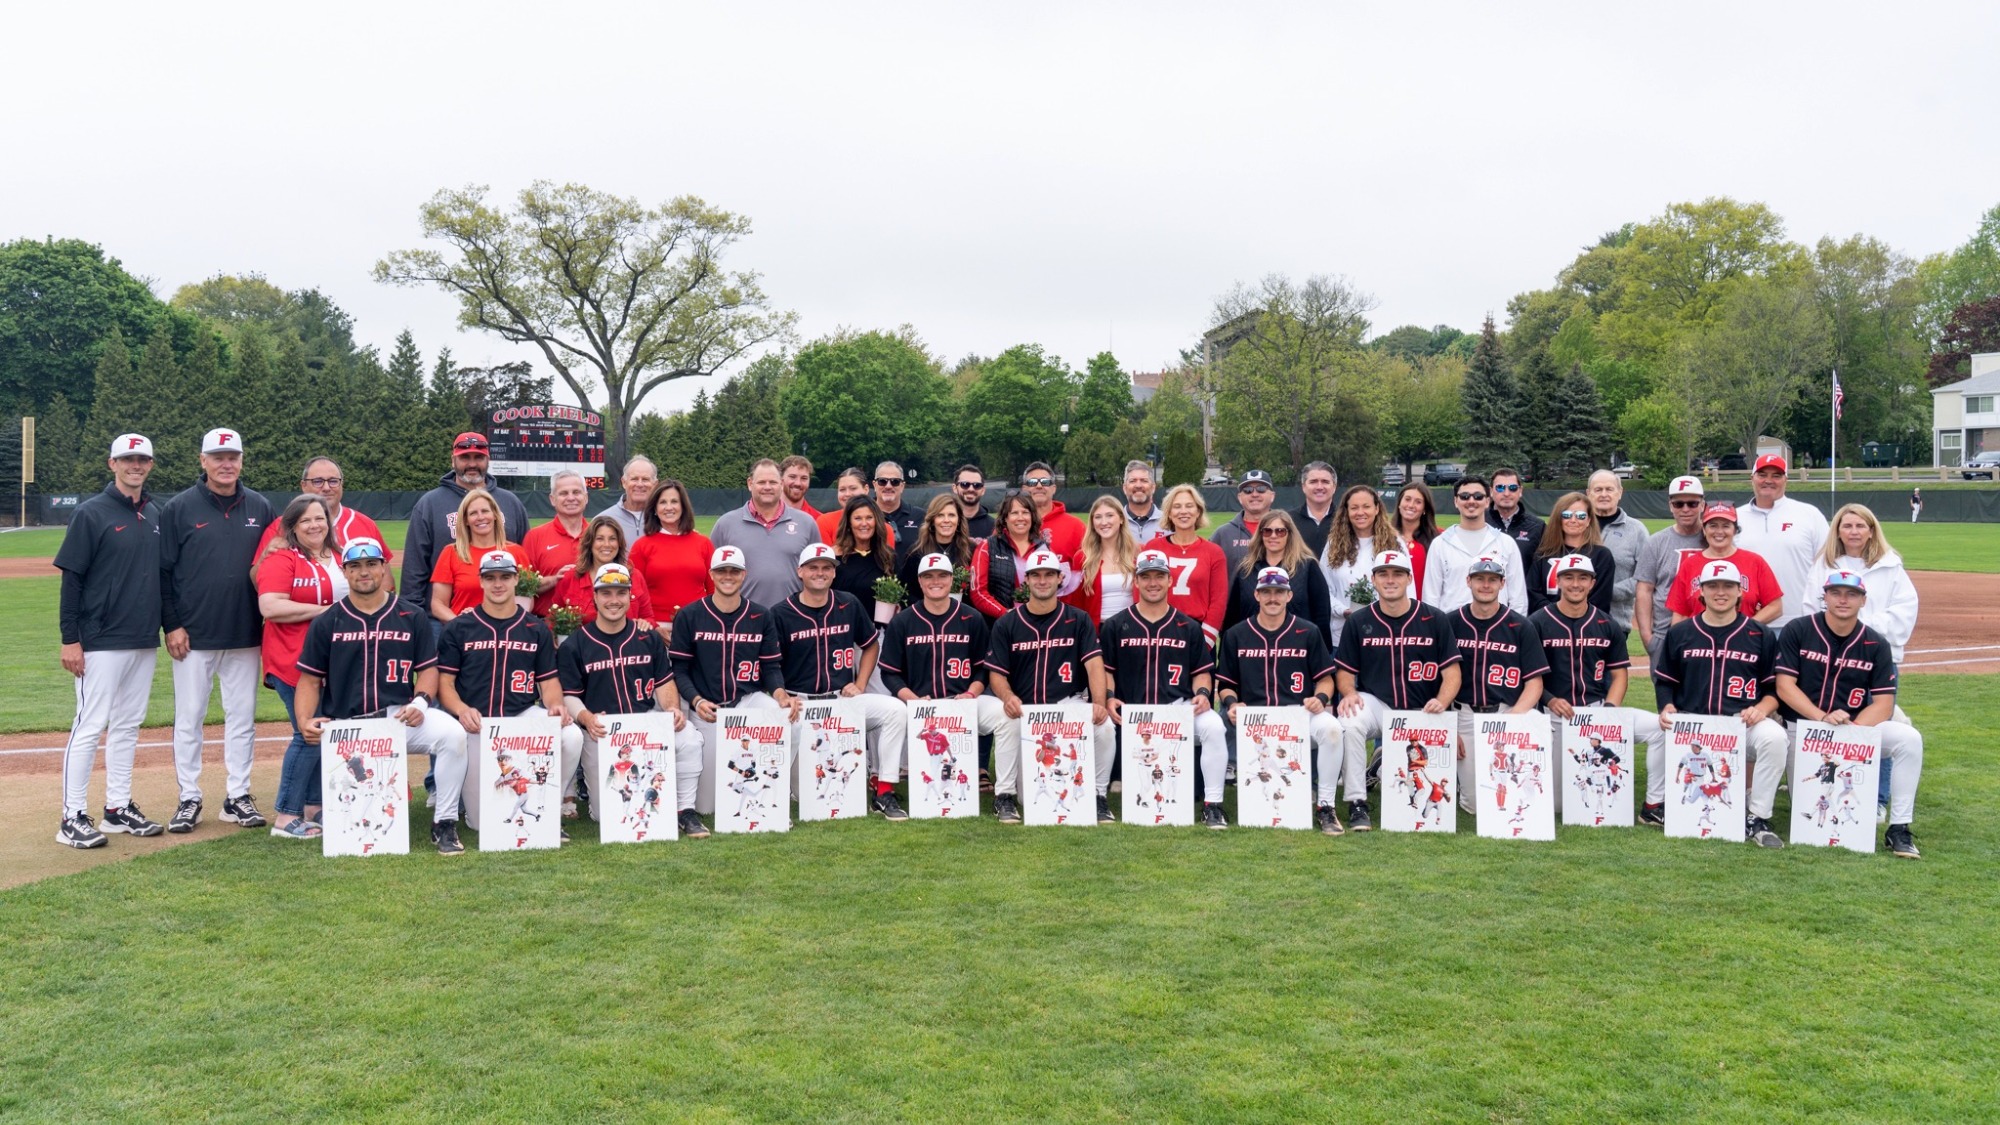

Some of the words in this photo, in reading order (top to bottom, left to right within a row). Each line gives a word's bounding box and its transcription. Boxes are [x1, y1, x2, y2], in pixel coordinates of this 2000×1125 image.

[493, 406, 545, 423] COOK
[548, 405, 600, 426] FIELD
[128, 437, 144, 450] F
[218, 433, 233, 446] F
[522, 434, 528, 443] 0
[544, 434, 550, 444] 0
[566, 434, 572, 444] 0
[1766, 454, 1778, 463] F
[1679, 480, 1694, 491] F
[62, 497, 77, 505] 325
[1782, 522, 1793, 531] F
[722, 550, 735, 562] F
[815, 546, 828, 557] F
[928, 555, 942, 568] F
[1036, 554, 1050, 565] F
[1384, 553, 1398, 564] F
[1568, 556, 1583, 568] F
[1169, 557, 1198, 596] 7
[1713, 565, 1727, 577] F
[293, 577, 319, 588] AIR
[332, 630, 411, 642] FAIRFIELD
[694, 631, 763, 643] FAIRFIELD
[790, 624, 850, 642] FAIRFIELD
[906, 633, 970, 645] FAIRFIELD
[464, 640, 538, 652] FAIRFIELD
[1012, 637, 1075, 652] FAIRFIELD
[1120, 637, 1187, 649] FAIRFIELD
[1362, 636, 1434, 648] FAIRFIELD
[1456, 638, 1517, 653] AIRFIELD
[1542, 637, 1611, 648] FAIRFIELD
[833, 648, 854, 670] 38
[1238, 648, 1308, 658] FAIRFIELD
[1682, 648, 1759, 663] FAIRFIELD
[585, 654, 652, 674] FAIRFIELD
[1799, 649, 1874, 672] FAIRFIELD
[386, 658, 413, 683] 17
[947, 658, 971, 678] 36
[1058, 661, 1073, 683] 4
[1408, 660, 1439, 682] 20
[1594, 659, 1605, 681] 2
[511, 669, 535, 694] 22
[1168, 664, 1183, 686] 7
[1488, 663, 1521, 688] 29
[635, 677, 654, 701] 14
[1290, 671, 1305, 694] 3
[1727, 676, 1757, 700] 24
[1847, 688, 1865, 708] 6
[805, 707, 832, 720] KEVIN
[914, 706, 937, 719] JAKE
[1028, 711, 1064, 724] PAYTEN
[1129, 712, 1153, 724] LIAM
[724, 715, 747, 729] WILL
[822, 717, 841, 730] KELL
[1243, 714, 1267, 726] LUKE
[1389, 717, 1407, 730] JOE
[1569, 714, 1593, 726] LUKE
[489, 725, 500, 740] TJ
[609, 722, 622, 735] JP
[725, 726, 783, 740] YOUNGMAN
[1245, 724, 1290, 737] SPENCER
[1481, 721, 1507, 733] DOM
[1579, 725, 1622, 737] NOMURA
[1674, 721, 1703, 734] MATT
[330, 728, 361, 743] MATT
[610, 732, 648, 747] KUCZIK
[1392, 727, 1448, 741] CHAMBERS
[1487, 732, 1530, 745] CAMERA
[1804, 728, 1834, 742] ZACH
[491, 736, 554, 752] SCHMALZLE
[1802, 739, 1875, 758] STEPHENSON
[831, 809, 839, 817] F
[941, 808, 951, 816] F
[1057, 815, 1067, 824] F
[1155, 815, 1164, 823] F
[1272, 818, 1281, 826] F
[1595, 817, 1605, 825] F
[749, 822, 759, 830] F
[1415, 822, 1425, 830] F
[1513, 828, 1523, 836] F
[1701, 828, 1711, 837] F
[636, 831, 647, 840] F
[363, 843, 374, 853] F
[517, 838, 527, 847] F
[1829, 838, 1839, 847] F
